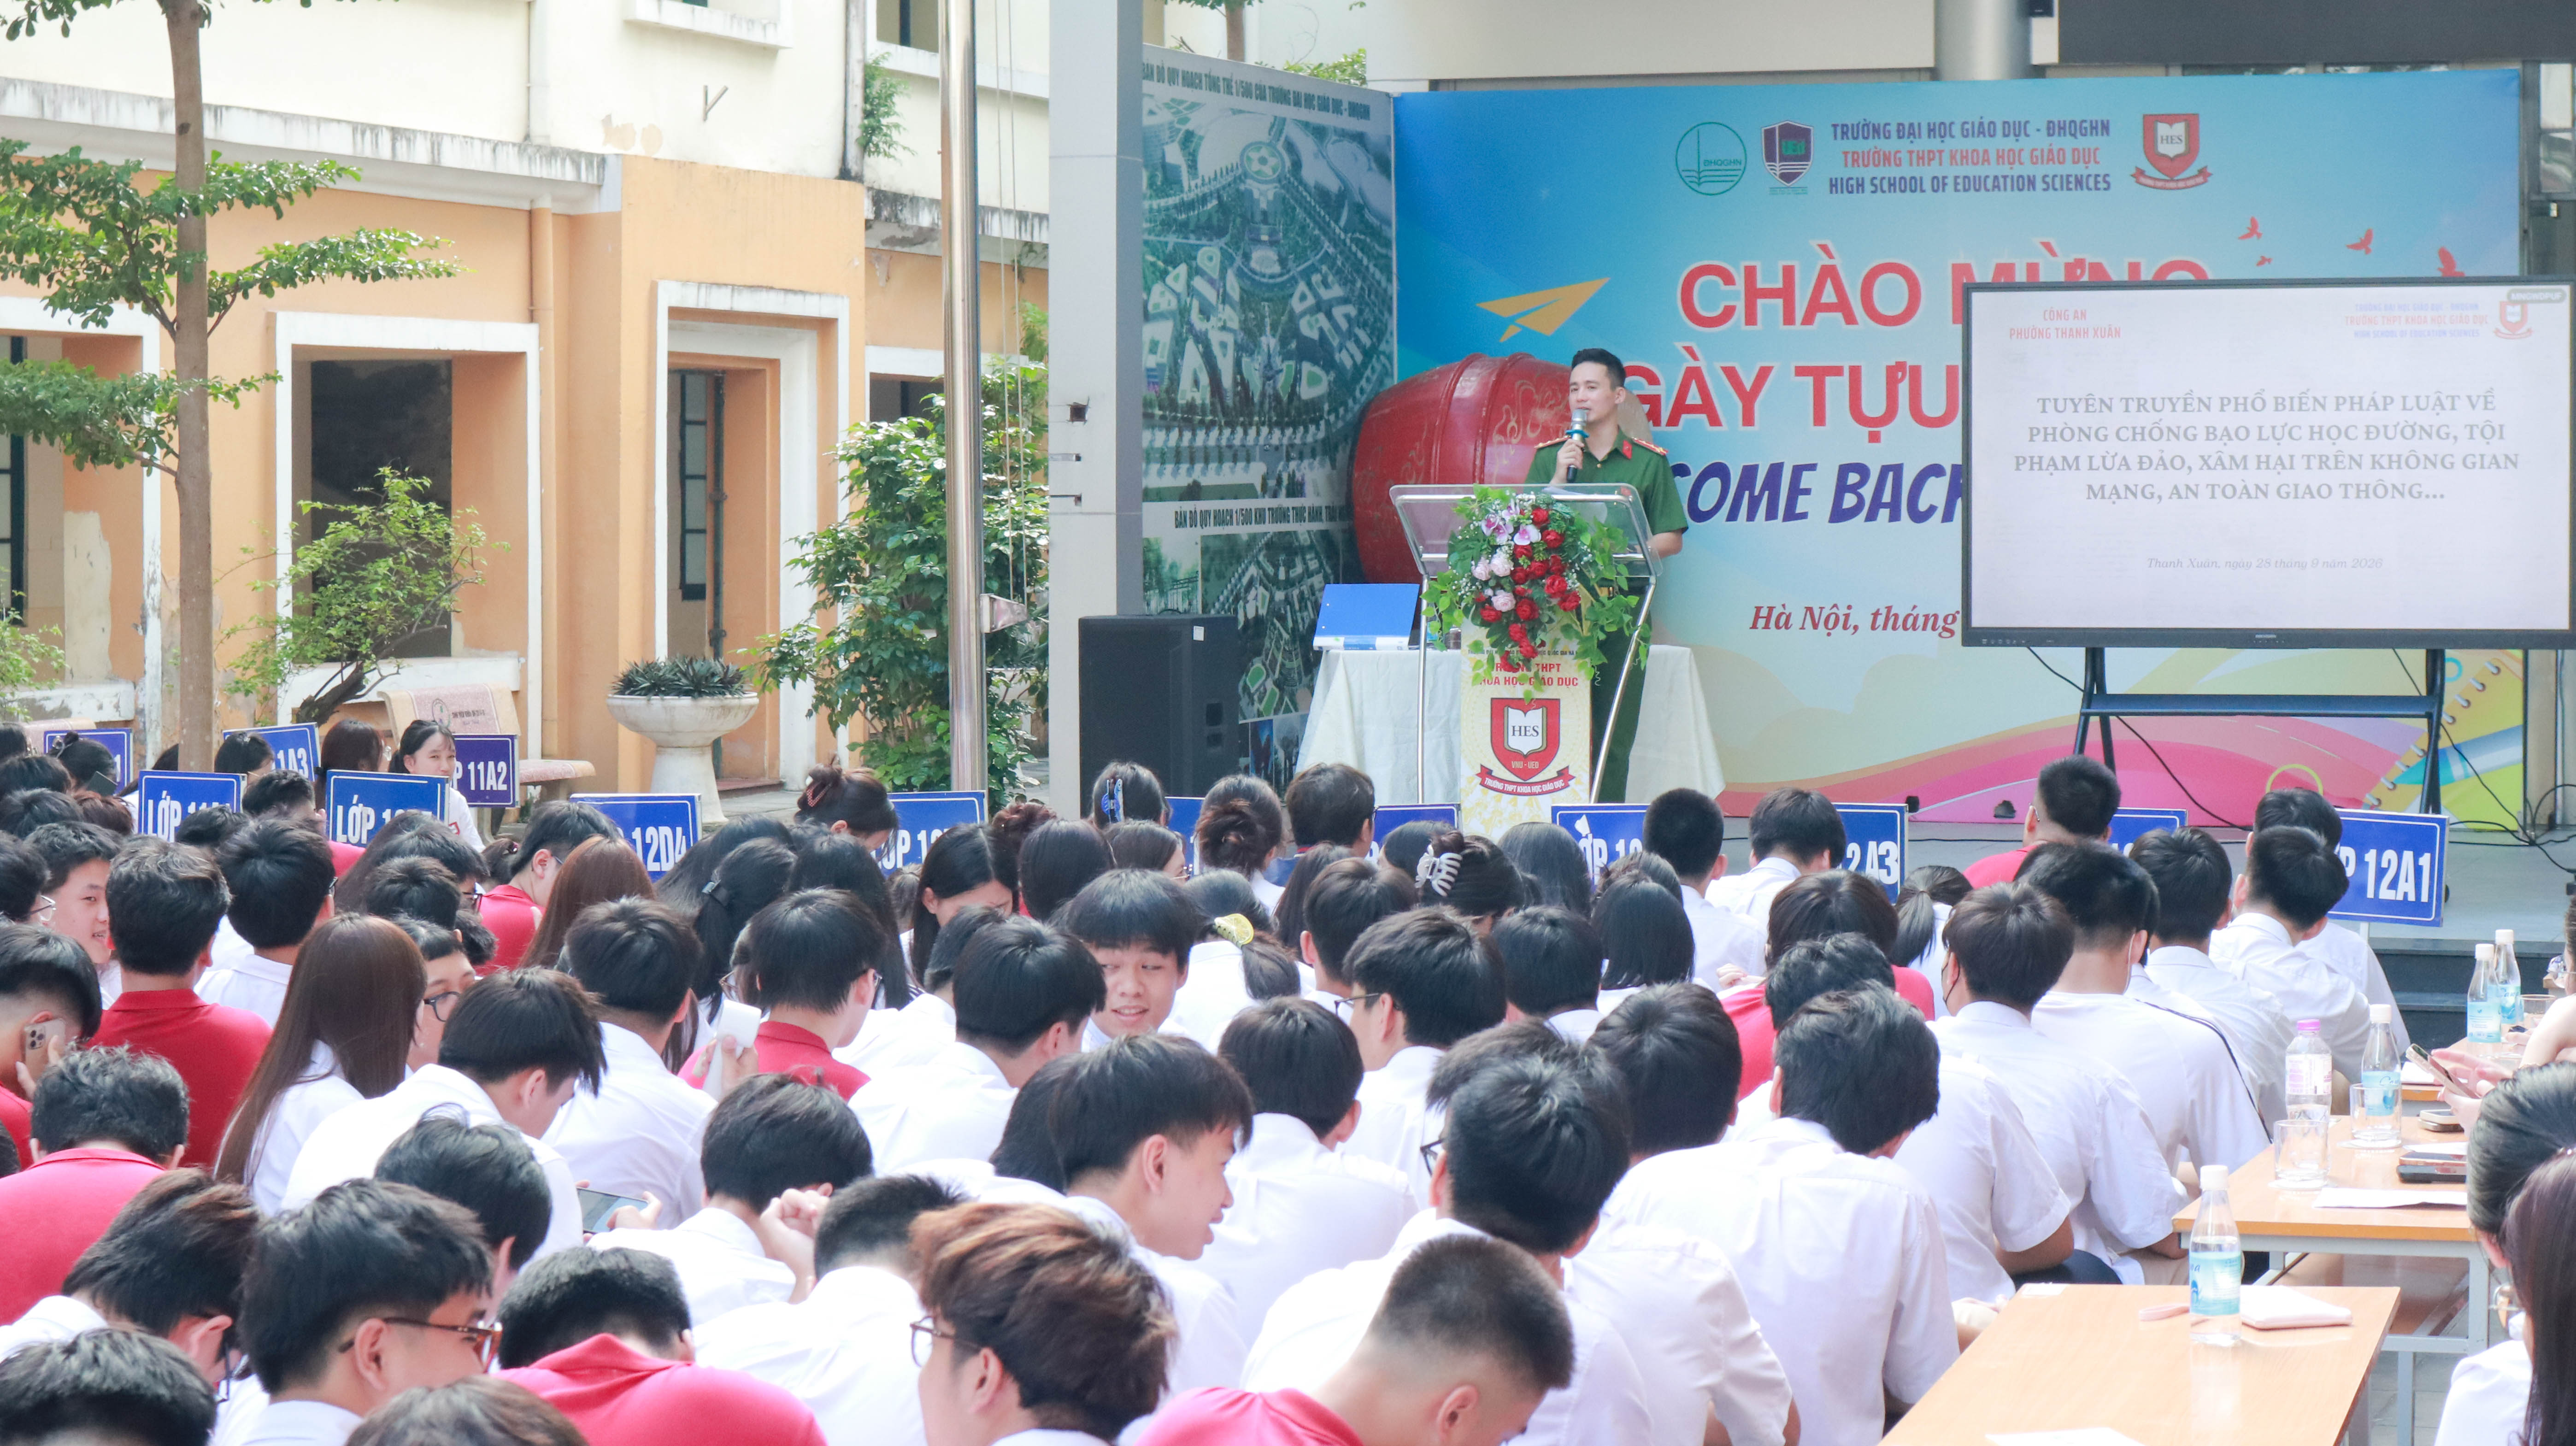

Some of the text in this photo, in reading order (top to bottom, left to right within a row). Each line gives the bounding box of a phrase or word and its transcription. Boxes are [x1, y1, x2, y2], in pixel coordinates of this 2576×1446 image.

[1831, 118, 1891, 140] TRƯỜNG
[1896, 122, 1922, 144] ĐẠI
[1927, 121, 1956, 143] HỌC
[1961, 116, 1997, 138] GIÁO
[2002, 120, 2030, 142] DỤC
[2046, 119, 2111, 139] ĐHQGHN
[2160, 135, 2183, 145] HES
[1842, 143, 2100, 170] TRƯỜNG THPT KHOA HỌC GIÁO DỤC
[1829, 177, 1865, 194] HIGH
[1870, 176, 1926, 194] SCHOOL
[1931, 175, 1948, 192] OF
[1953, 175, 2036, 193] EDUCATION
[2042, 173, 2111, 192] SCIENCES
[1679, 244, 1923, 328] CHÀO
[2043, 306, 2087, 321] CÔNG AN
[2382, 315, 2402, 325] THPT
[2405, 315, 2428, 325] KHOA
[2055, 327, 2089, 339] THANH
[2093, 324, 2121, 339] XUÂN
[1795, 361, 1959, 443] TỰU
[2037, 387, 2496, 416] TUYÊN TRUYỀN PHỔ BIẾN PHÁP LUẬT VỀ
[2028, 418, 2505, 446] PHÒNG CHỐNG BẠO LỰC HỌC ĐƯỜNG, TỘI
[2014, 449, 2519, 476] PHẠM LỪA ĐẢO, XÂM HẠI TRÊN KHÔNG GIAN
[2086, 479, 2445, 505] MẠNG, AN TOÀN GIAO THÔNG...
[1175, 506, 1188, 529] BẢN
[1200, 509, 1212, 529] QUY
[1213, 508, 1234, 530] HOẠCH
[1235, 507, 1253, 526] 1/500
[1254, 507, 1266, 525] KHU
[2147, 558, 2183, 569] Thanh
[2187, 558, 2221, 570] Xuân,
[2225, 558, 2253, 570] ngày
[2255, 558, 2271, 568] 28
[2274, 558, 2308, 570] tháng
[2311, 558, 2319, 568] 9
[1749, 603, 1960, 639] Hà Nội, tháng
[1535, 663, 1561, 672] THPT
[1557, 677, 1578, 688] DỤC
[1511, 725, 1539, 737] HES
[467, 760, 508, 791] 11A2
[1484, 777, 1503, 790] TRƯỜNG
[1504, 784, 1517, 792] THPT
[1532, 785, 1542, 794] HỌC
[1542, 782, 1554, 792] GIÁO
[1554, 779, 1565, 788] DỤC
[147, 790, 182, 843] LỚP
[336, 794, 376, 844] LỚP
[632, 826, 687, 871] 12D4
[2364, 849, 2431, 902] 12A1
